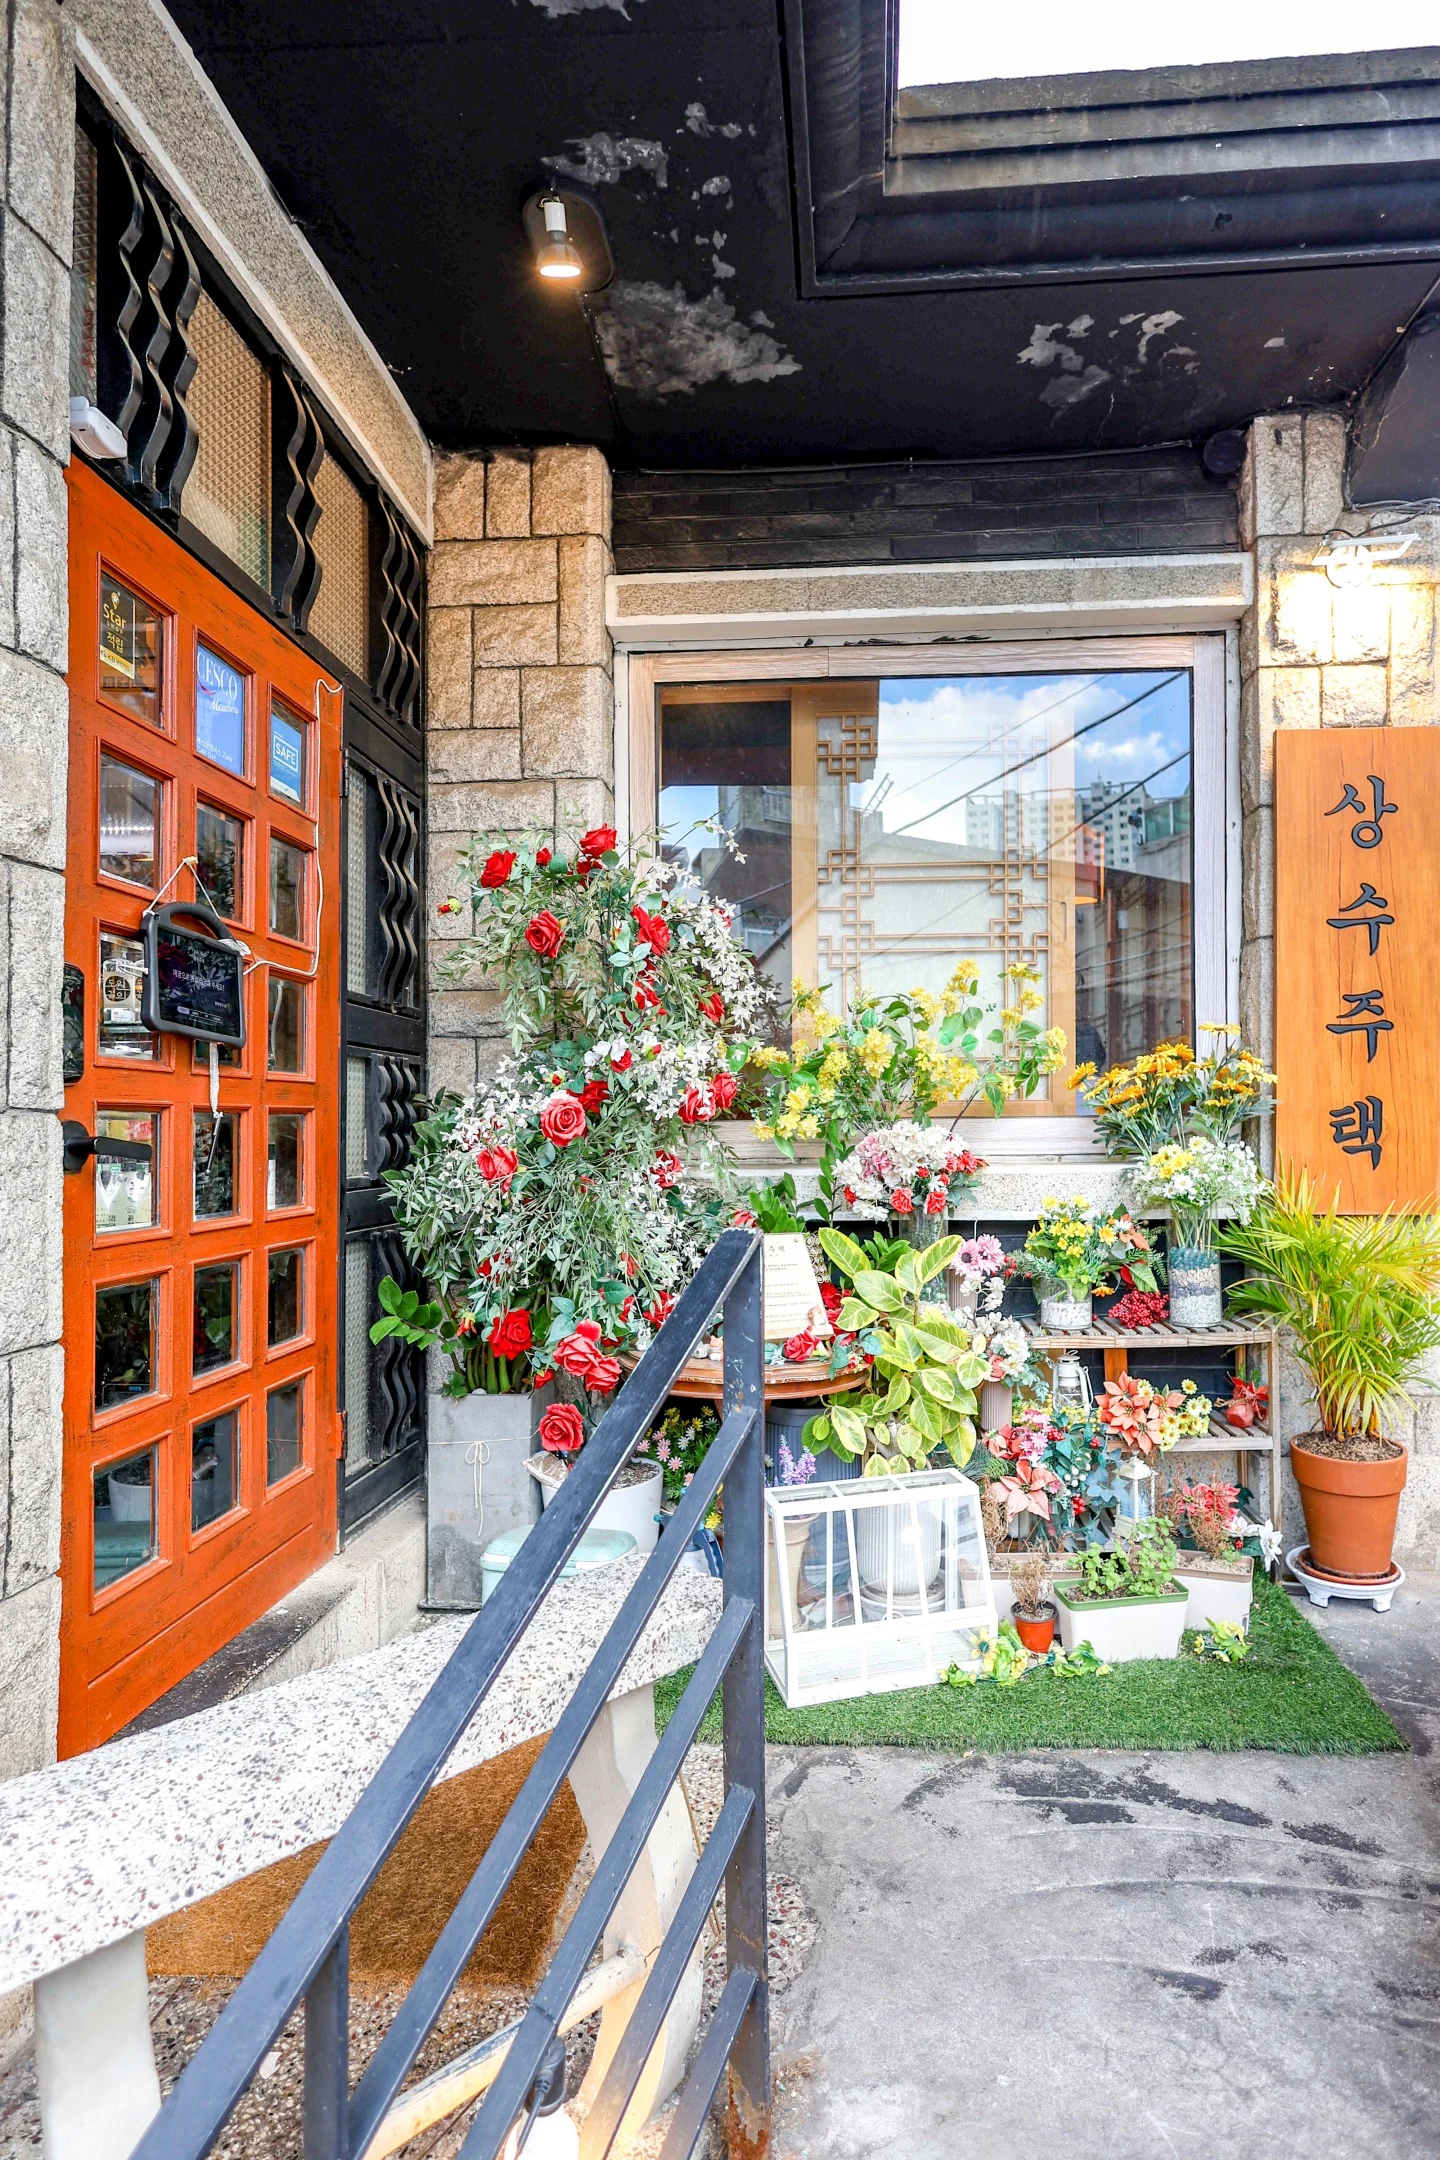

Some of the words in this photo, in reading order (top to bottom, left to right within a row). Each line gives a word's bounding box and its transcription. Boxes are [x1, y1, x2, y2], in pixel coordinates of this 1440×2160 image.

[103, 603, 126, 630] Star
[106, 631, 123, 654] 적립
[197, 652, 238, 701] CESCO
[210, 698, 239, 714] Members
[275, 742, 296, 765] SAFE
[1324, 774, 1399, 1171] 상수주택
